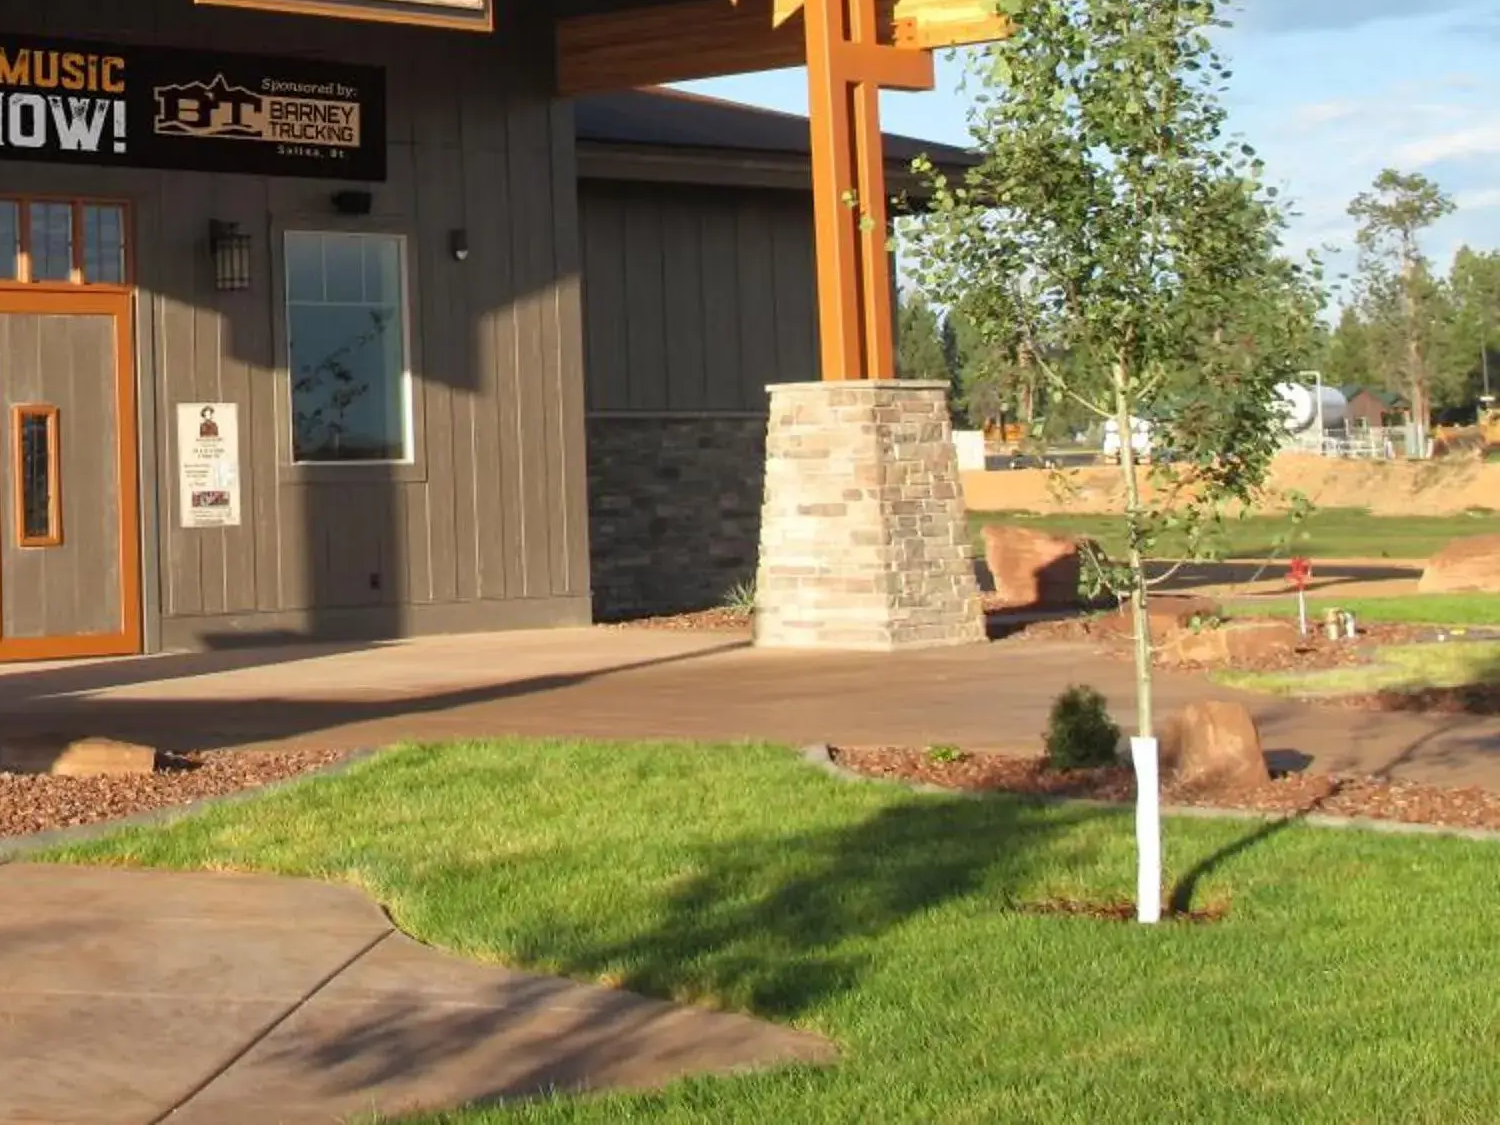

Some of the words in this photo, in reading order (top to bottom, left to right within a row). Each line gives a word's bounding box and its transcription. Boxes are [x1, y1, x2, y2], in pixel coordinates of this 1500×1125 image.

[261, 77, 334, 95] Sponsored
[269, 100, 353, 124] BARNEY
[268, 121, 353, 142] TRUCKING
